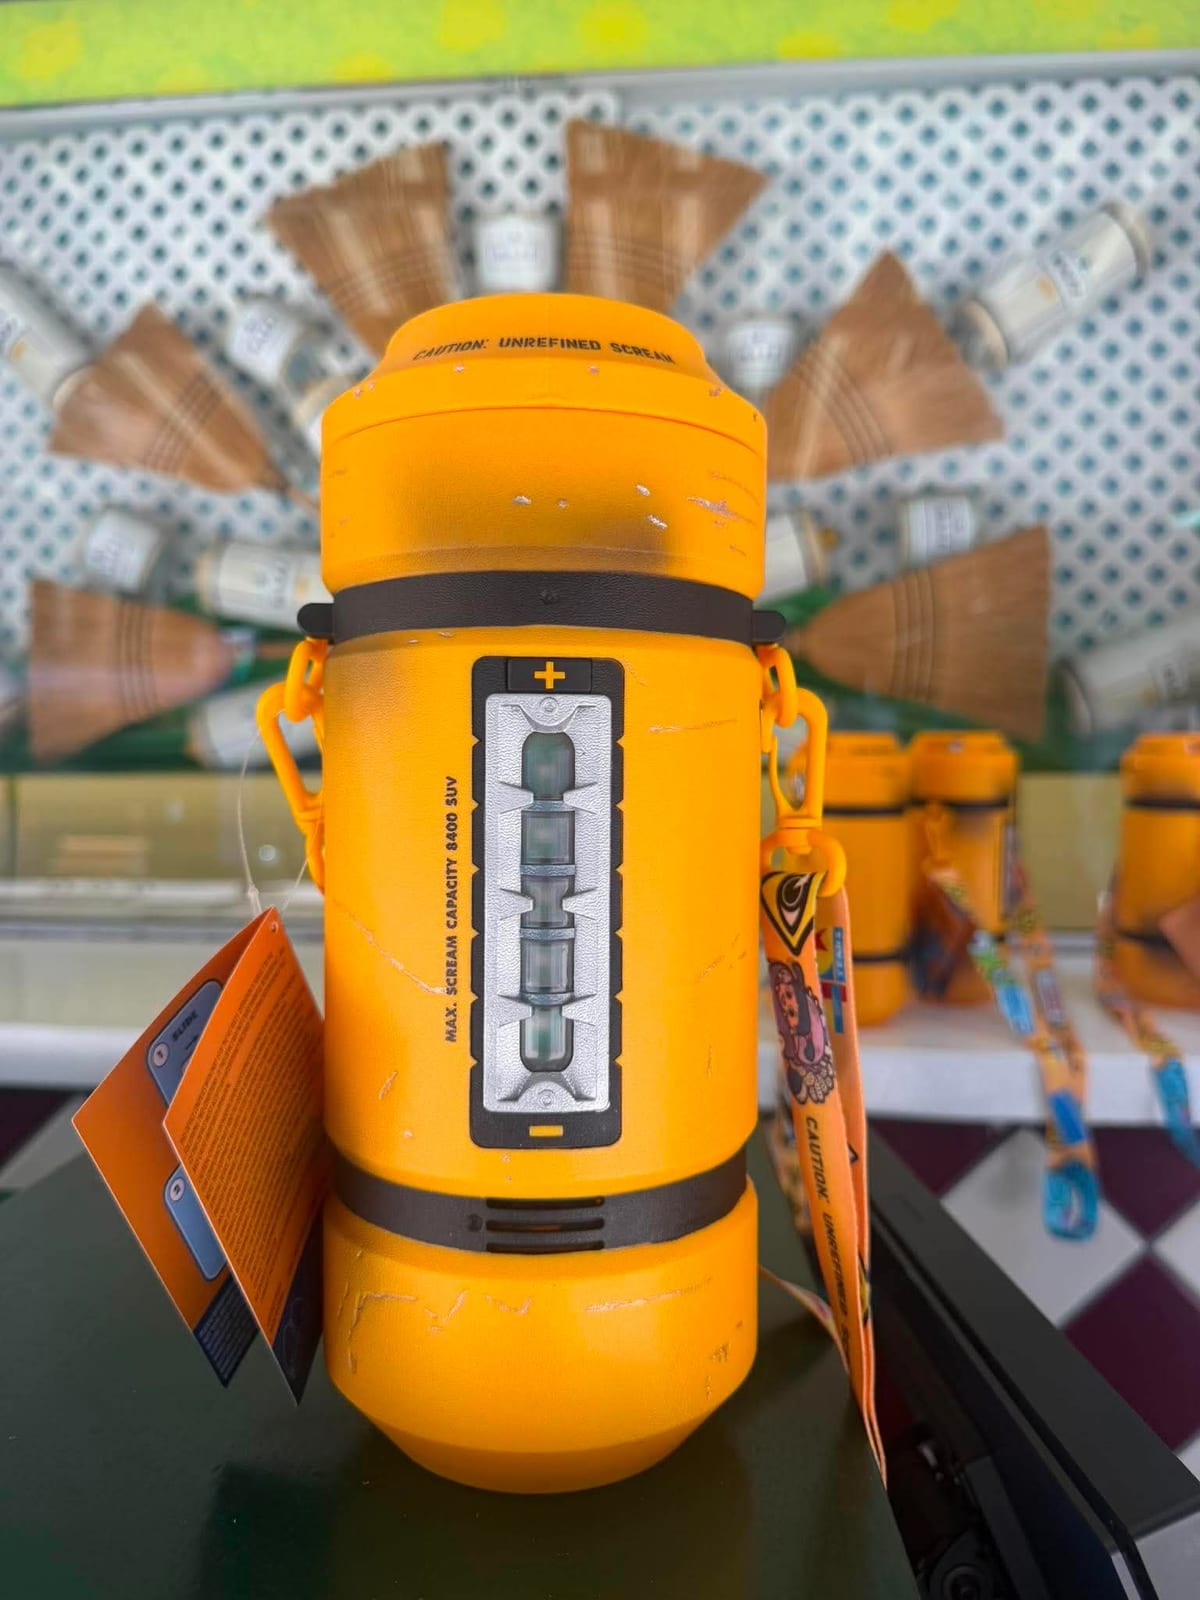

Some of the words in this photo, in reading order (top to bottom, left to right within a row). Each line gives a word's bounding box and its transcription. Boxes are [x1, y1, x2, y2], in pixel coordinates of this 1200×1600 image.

[412, 338, 489, 361] CAUTION:
[498, 336, 602, 351] UNREFINED
[608, 341, 675, 365] SCREAM
[445, 776, 458, 806] SUV
[445, 812, 458, 851] 8400
[445, 857, 458, 929] CAPACITY
[445, 935, 458, 996] SCREAM
[444, 1002, 457, 1042] MAX.
